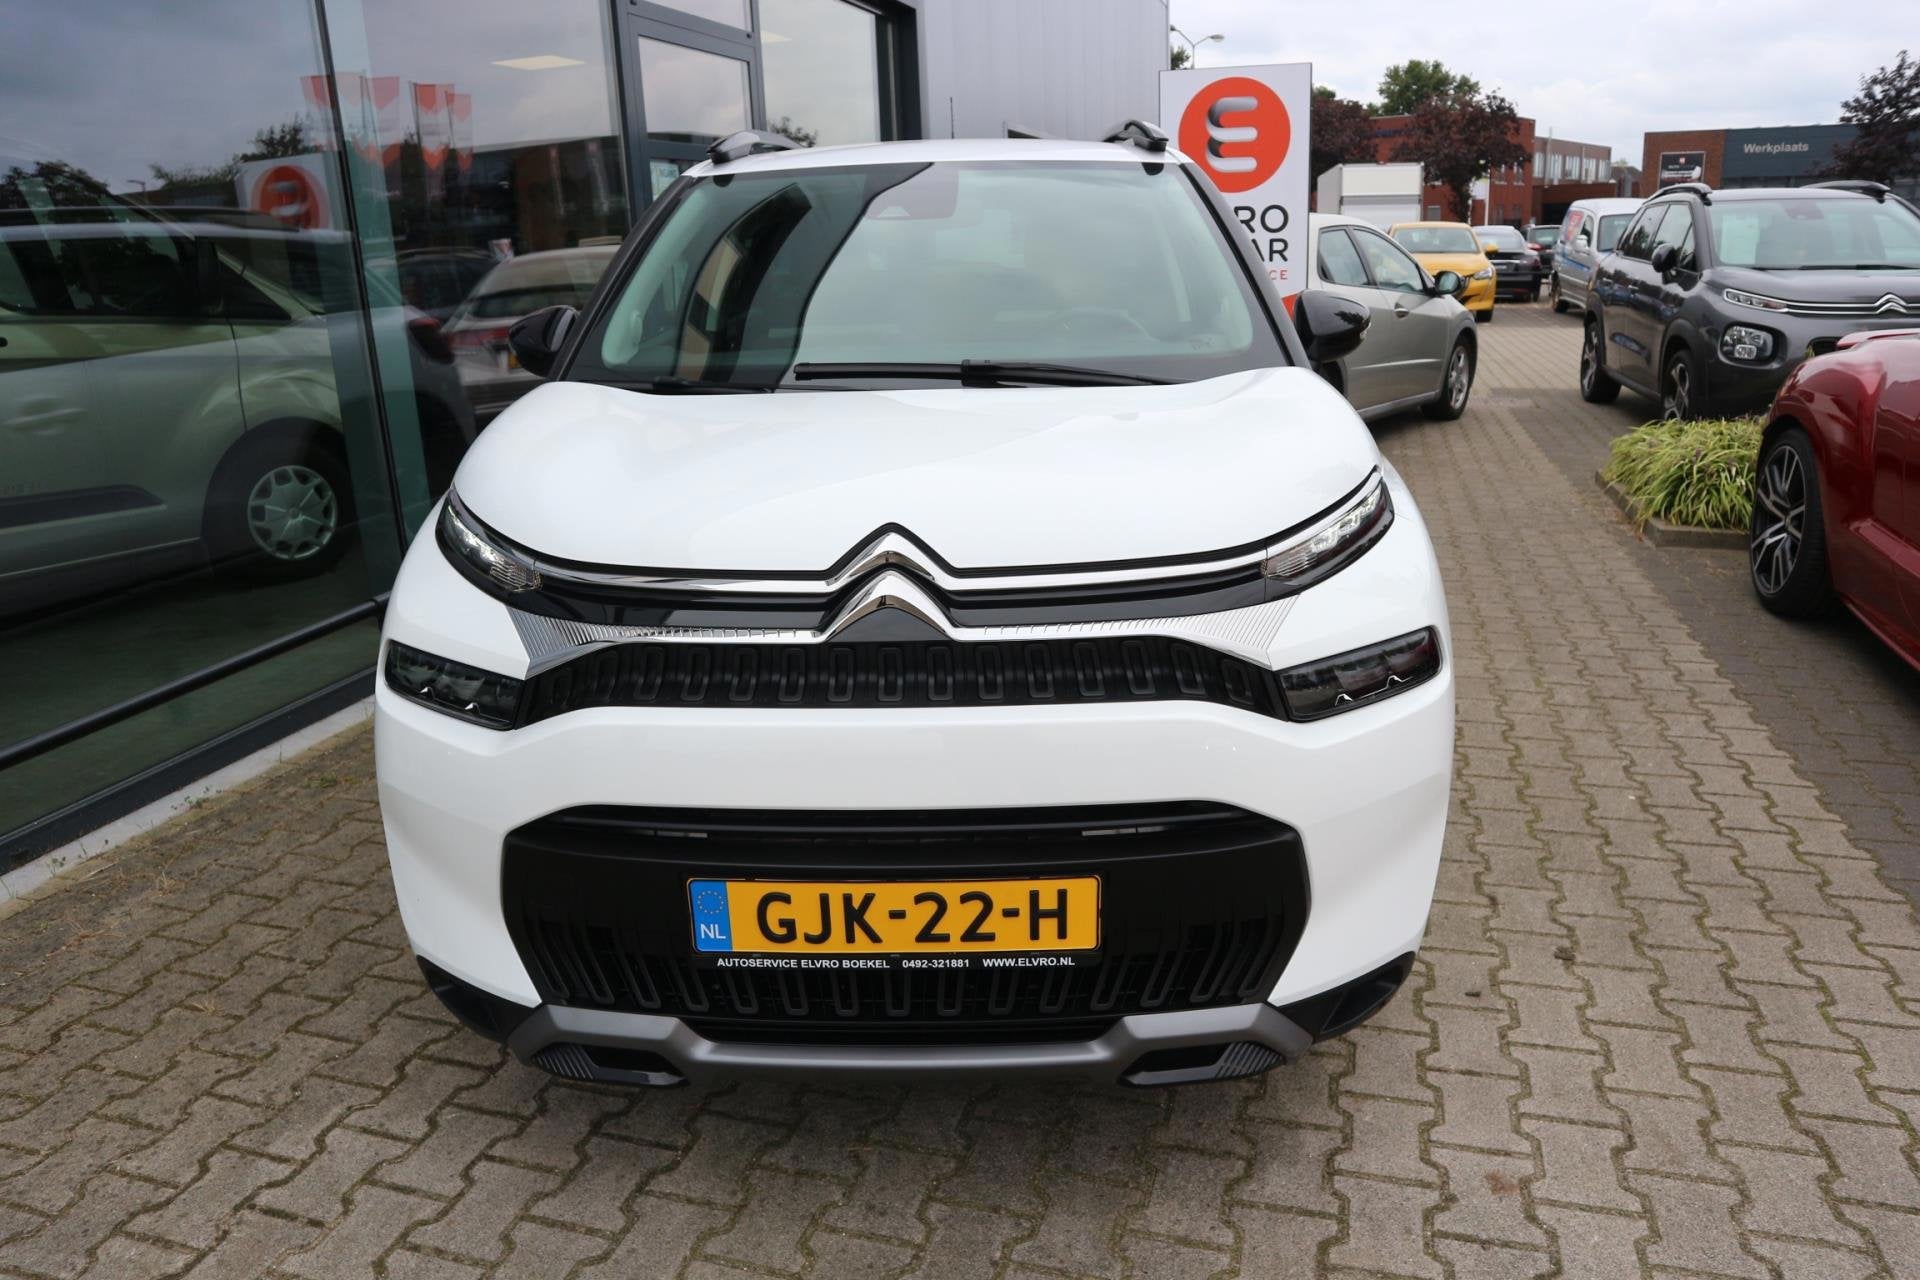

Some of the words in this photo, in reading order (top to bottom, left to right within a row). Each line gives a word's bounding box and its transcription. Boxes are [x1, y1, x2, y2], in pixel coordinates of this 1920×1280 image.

[1744, 141, 1809, 155] Werkplaats
[1233, 204, 1289, 234] RO
[755, 888, 1068, 944] GJK-22-H
[700, 923, 727, 940] NL
[716, 957, 799, 969] AUTOSERVICE
[801, 959, 839, 969] ELVRO
[842, 959, 890, 969] BOEKEL
[902, 959, 970, 969] 0492-321881
[982, 956, 1076, 968] WWW.ELVRO.NL
